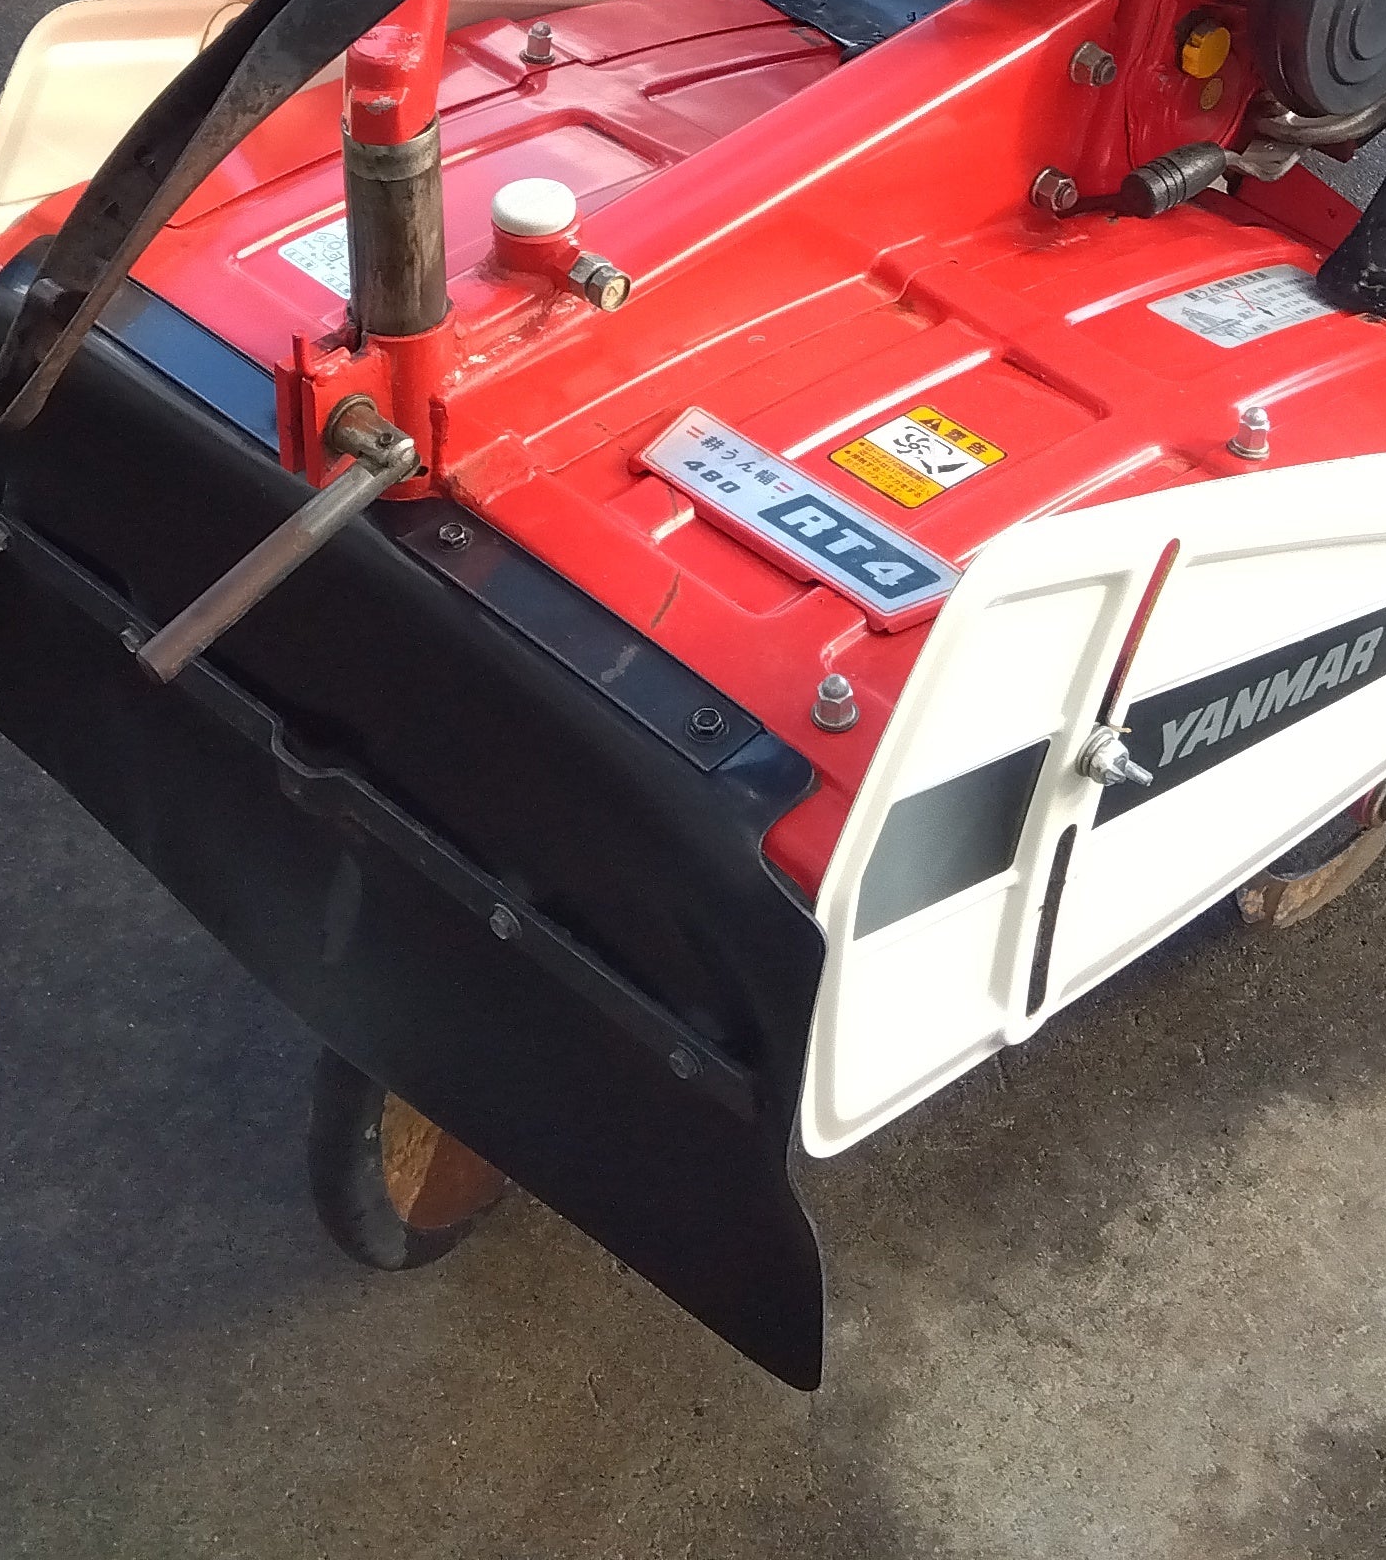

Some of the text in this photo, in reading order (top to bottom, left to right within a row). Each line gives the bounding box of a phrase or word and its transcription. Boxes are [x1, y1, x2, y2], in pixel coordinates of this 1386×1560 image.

[683, 460, 741, 494] 480
[700, 435, 781, 487] 耕うん幅
[779, 505, 915, 586] RT4
[1159, 626, 1384, 767] YANMAR
